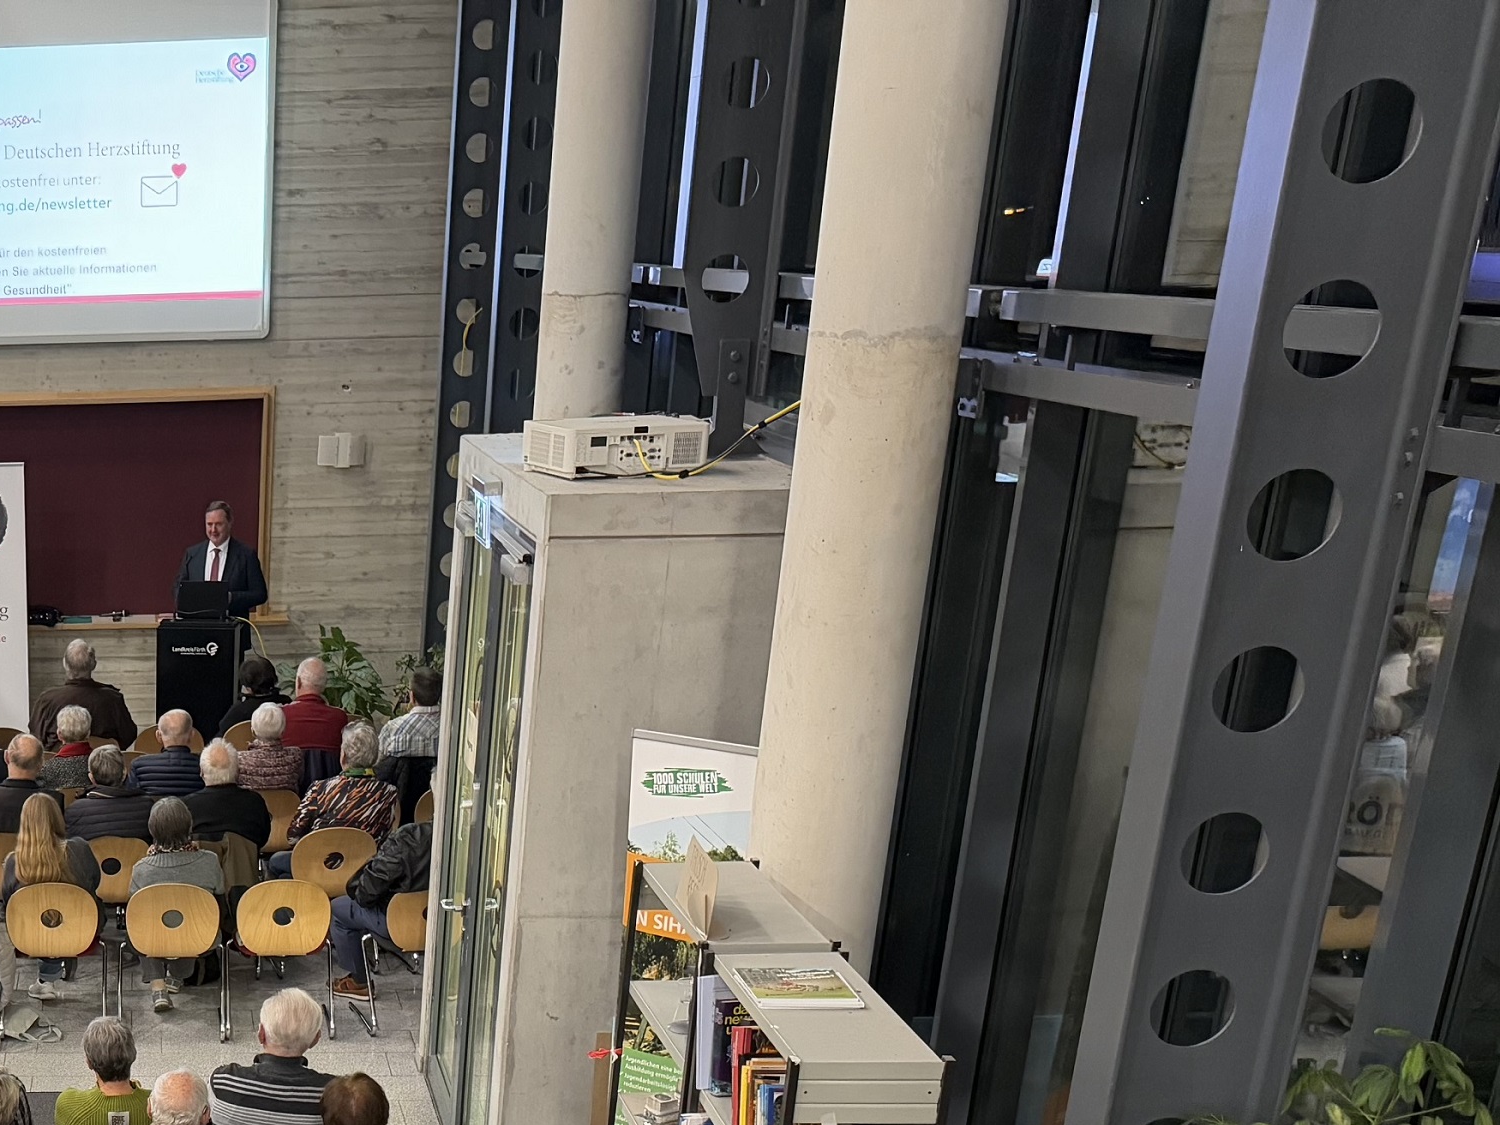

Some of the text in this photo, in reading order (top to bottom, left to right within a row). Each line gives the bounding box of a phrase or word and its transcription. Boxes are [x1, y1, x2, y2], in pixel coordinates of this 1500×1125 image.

[4, 142, 82, 160] Deutschen
[88, 139, 181, 159] Herzstiftung
[13, 247, 34, 257] den
[37, 245, 107, 257] kostenfreien
[12, 266, 29, 276] Sie
[32, 265, 75, 276] aktuelle
[79, 263, 157, 274] Informationen
[652, 771, 719, 785] 1000 SCHULEN
[668, 783, 697, 794] UNSERE
[698, 782, 719, 793] WELT
